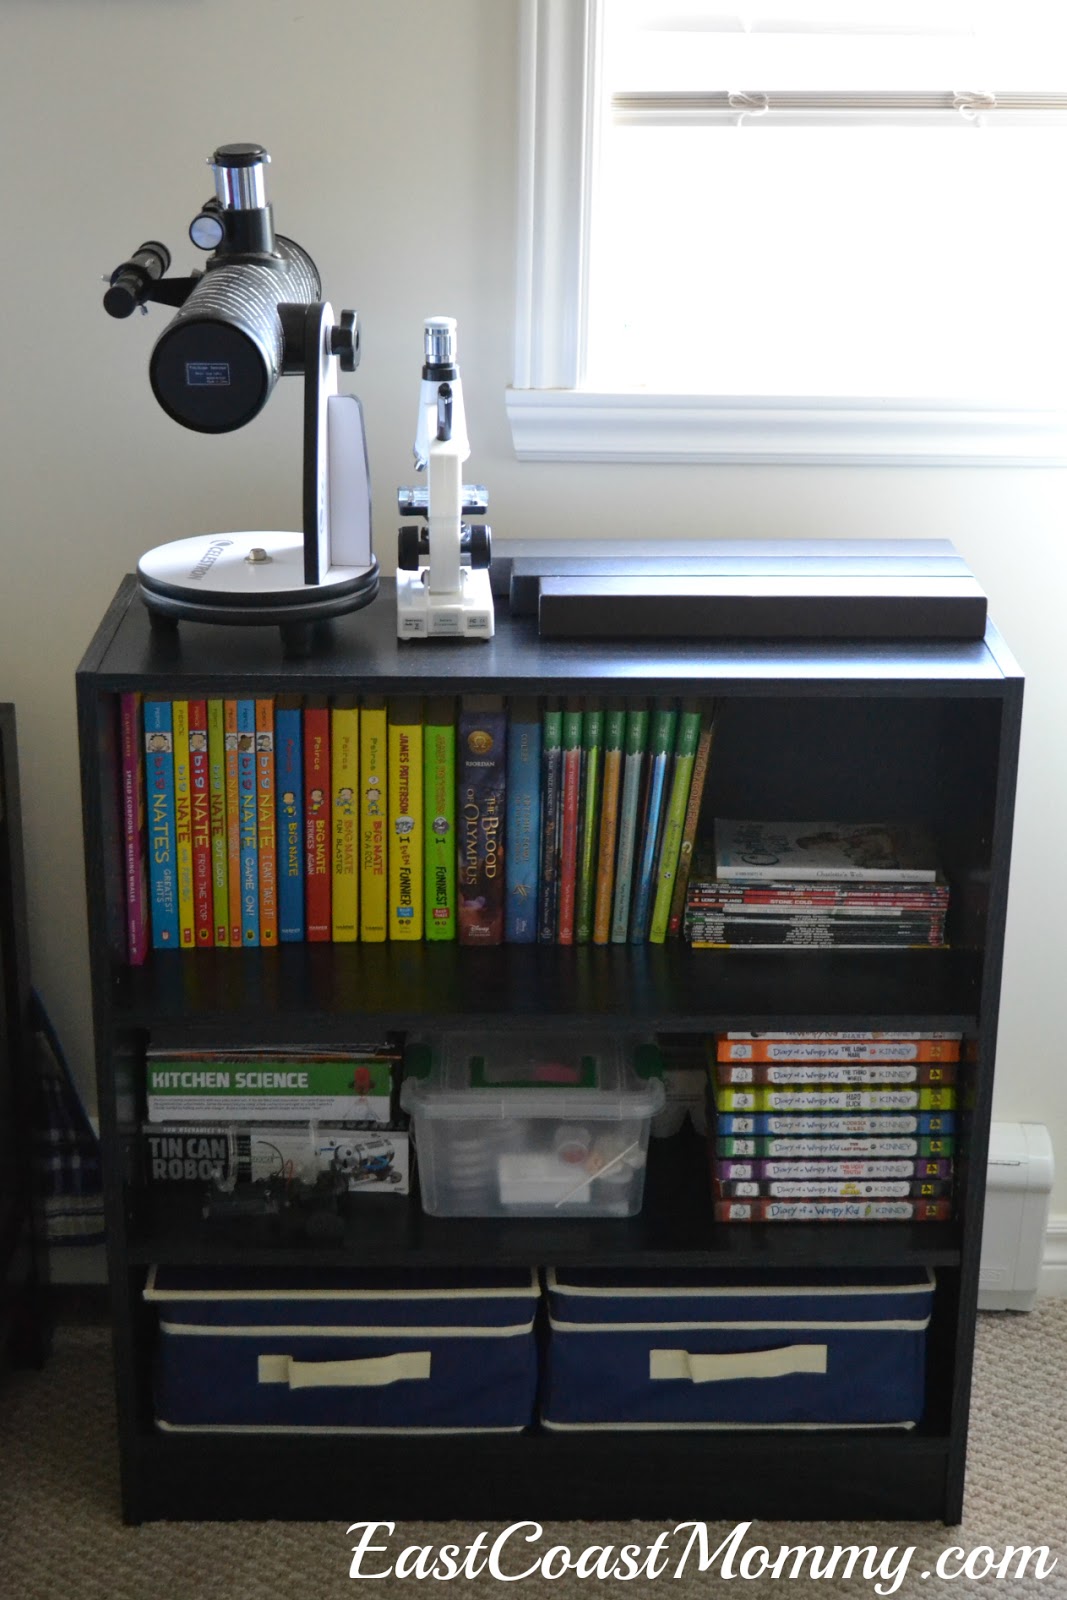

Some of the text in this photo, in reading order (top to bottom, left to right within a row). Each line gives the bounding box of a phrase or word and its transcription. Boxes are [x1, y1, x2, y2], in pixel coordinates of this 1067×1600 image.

[187, 547, 224, 581] CELESTRON
[313, 736, 322, 771] Peirce
[342, 736, 350, 770] Peirce
[194, 755, 205, 789] big
[260, 756, 271, 789] big
[399, 733, 410, 815] JAMES PATTERSON
[178, 796, 192, 844] NATE
[193, 793, 210, 849] NATE
[211, 793, 225, 837] NATE
[241, 794, 258, 850] NATE
[259, 793, 275, 850] NATE
[152, 793, 171, 865] NATE'S
[364, 831, 373, 842] ON
[480, 796, 500, 879] THE BLOOD
[306, 820, 315, 876] STRIKES AGAIN
[400, 845, 411, 866] EVEN
[463, 803, 480, 886] OLYMPUS
[128, 843, 136, 873] WALKING
[288, 846, 299, 878] NATE
[315, 844, 327, 875] NATE
[335, 838, 343, 875] BLASTER
[344, 844, 354, 875] NATE
[364, 850, 373, 870] ROLL
[373, 845, 384, 877] NATE
[216, 862, 225, 888] LOUD
[245, 857, 255, 891] GAME
[156, 881, 165, 904] HITS
[163, 868, 173, 914] GREATEST
[199, 880, 207, 899] THE
[263, 886, 274, 906] TAKE
[399, 867, 413, 906] FUNNIER
[435, 866, 448, 907] FUNNIEST
[200, 901, 208, 921] TOP
[245, 895, 255, 917] ON!
[773, 1048, 795, 1058] Diary
[805, 1048, 827, 1059] Wimpy
[828, 1048, 839, 1056] Kid
[878, 1047, 912, 1056] KINNEY
[152, 1072, 309, 1089] KITCHEN SCIENCE
[773, 1072, 795, 1082] Diary
[805, 1072, 827, 1082] Wimpy
[828, 1071, 839, 1079] Kid
[879, 1070, 912, 1079] KINNEY
[774, 1097, 796, 1106] Diary
[806, 1096, 828, 1107] Wimpy
[829, 1096, 840, 1104] Kid
[879, 1095, 912, 1104] KINNEY
[774, 1121, 796, 1131] Diary
[806, 1121, 828, 1131] Wimpy
[829, 1120, 840, 1128] Kid
[879, 1120, 911, 1129] KINNEY
[148, 1137, 226, 1159] TIN CAN
[774, 1144, 796, 1154] Diary
[807, 1144, 828, 1154] Wimpy
[829, 1143, 840, 1151] Kid
[879, 1142, 911, 1151] KINNEY
[152, 1158, 226, 1180] ROBOT
[773, 1166, 795, 1176] Diary
[805, 1166, 826, 1176] Wimpy
[827, 1165, 838, 1173] Kid
[876, 1165, 908, 1174] KINNEY
[806, 1187, 826, 1196] Wimpy
[874, 1185, 905, 1193] KINNEY
[771, 1205, 799, 1217] Diary
[815, 1205, 843, 1218] Wimpy
[845, 1205, 860, 1215] Kid
[875, 1206, 908, 1215] KINNEY
